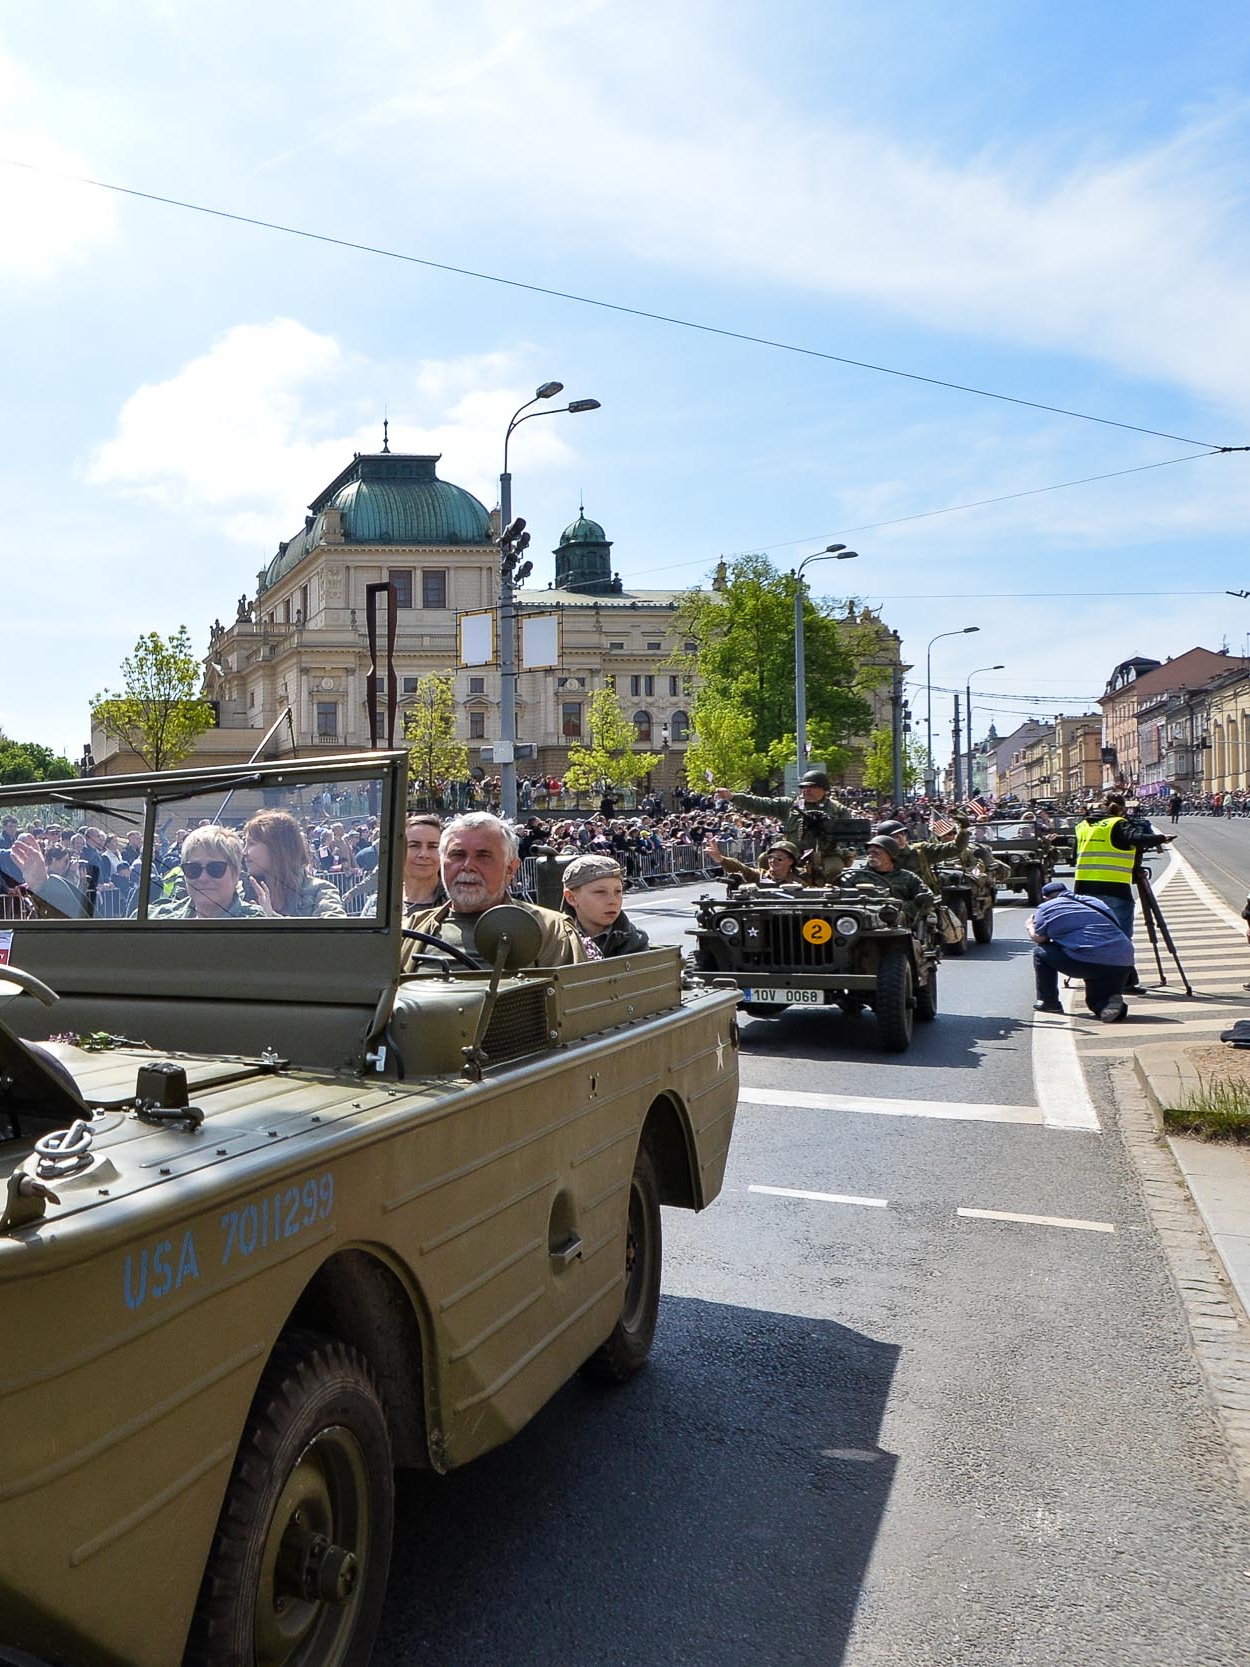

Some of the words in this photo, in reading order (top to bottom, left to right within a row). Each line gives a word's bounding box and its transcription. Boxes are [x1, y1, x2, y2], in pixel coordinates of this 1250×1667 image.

[811, 924, 823, 939] 2
[754, 990, 776, 1001] 10V
[786, 991, 818, 1003] 0068
[221, 1172, 335, 1266] 7011299
[124, 1231, 199, 1310] USA
